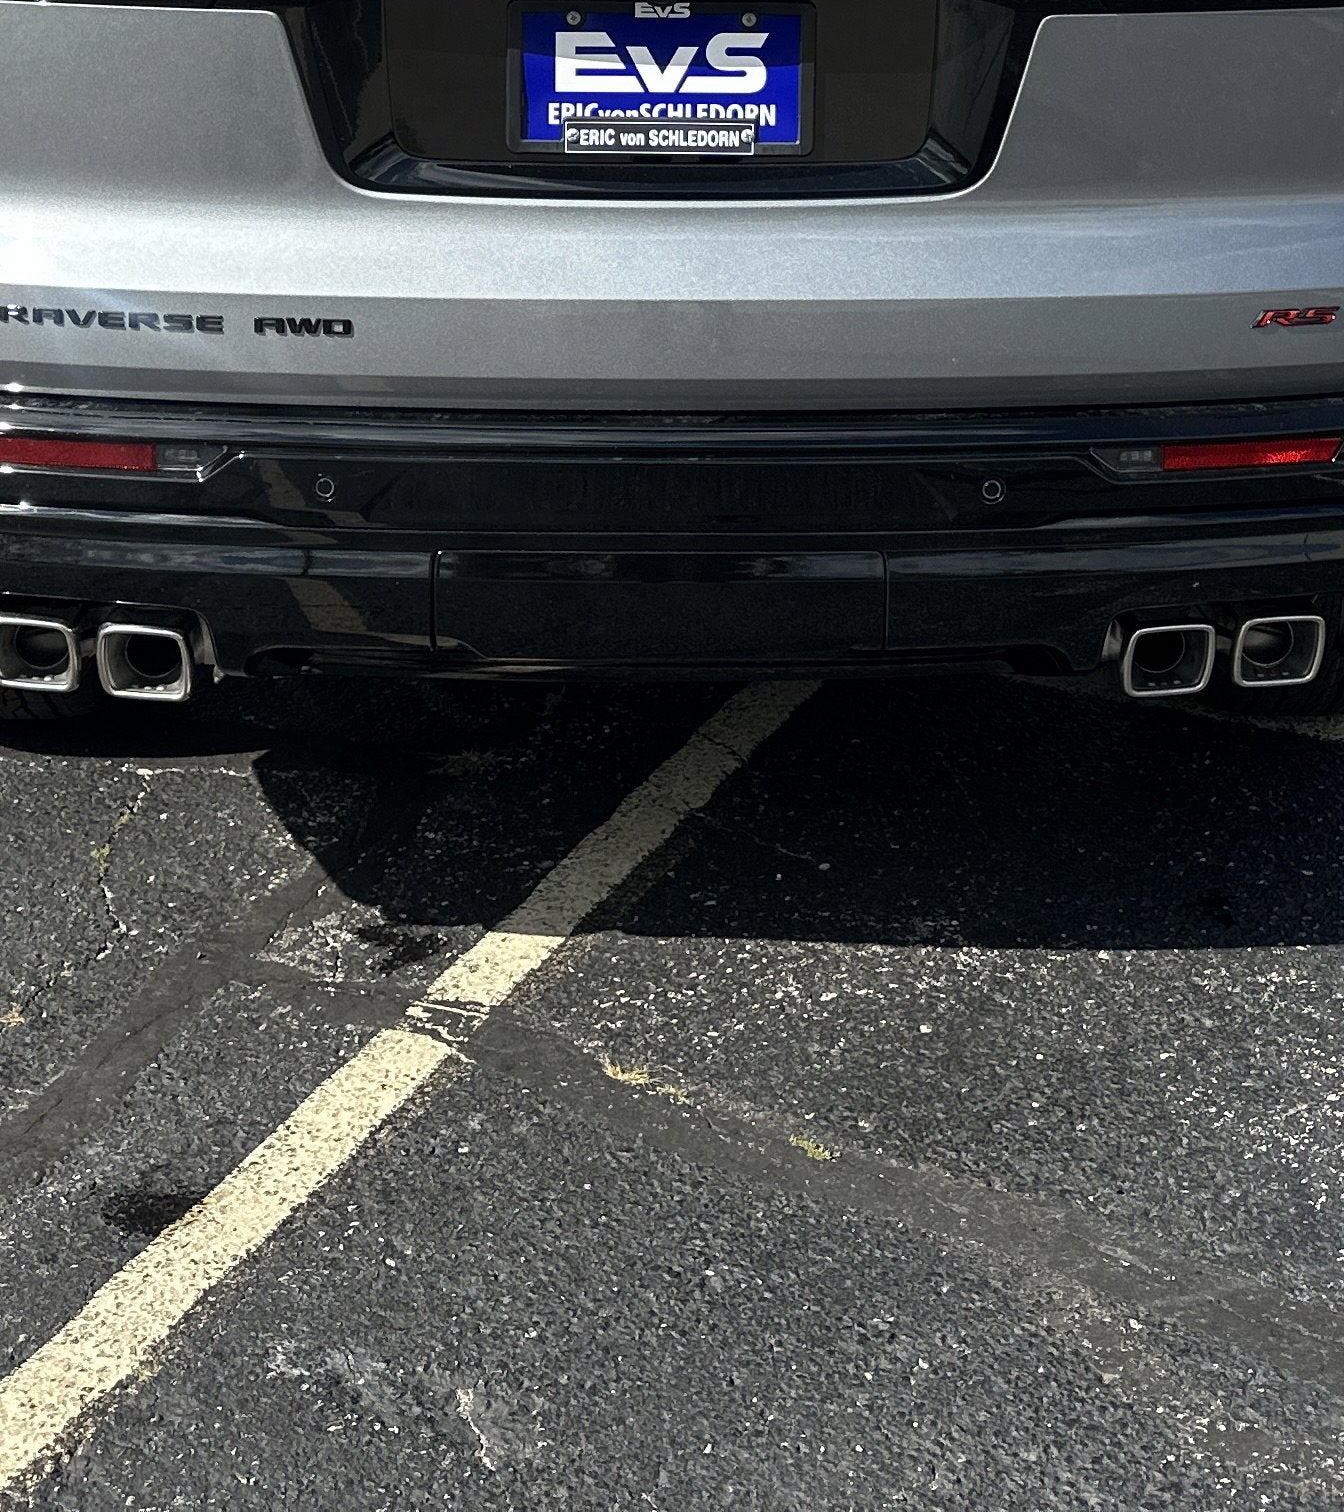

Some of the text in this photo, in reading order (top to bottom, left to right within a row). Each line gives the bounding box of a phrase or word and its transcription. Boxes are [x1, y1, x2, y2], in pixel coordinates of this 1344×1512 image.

[579, 128, 740, 148] ERIC von SCHLEDORN
[253, 316, 356, 338] AWD
[1249, 306, 1340, 329] RS
